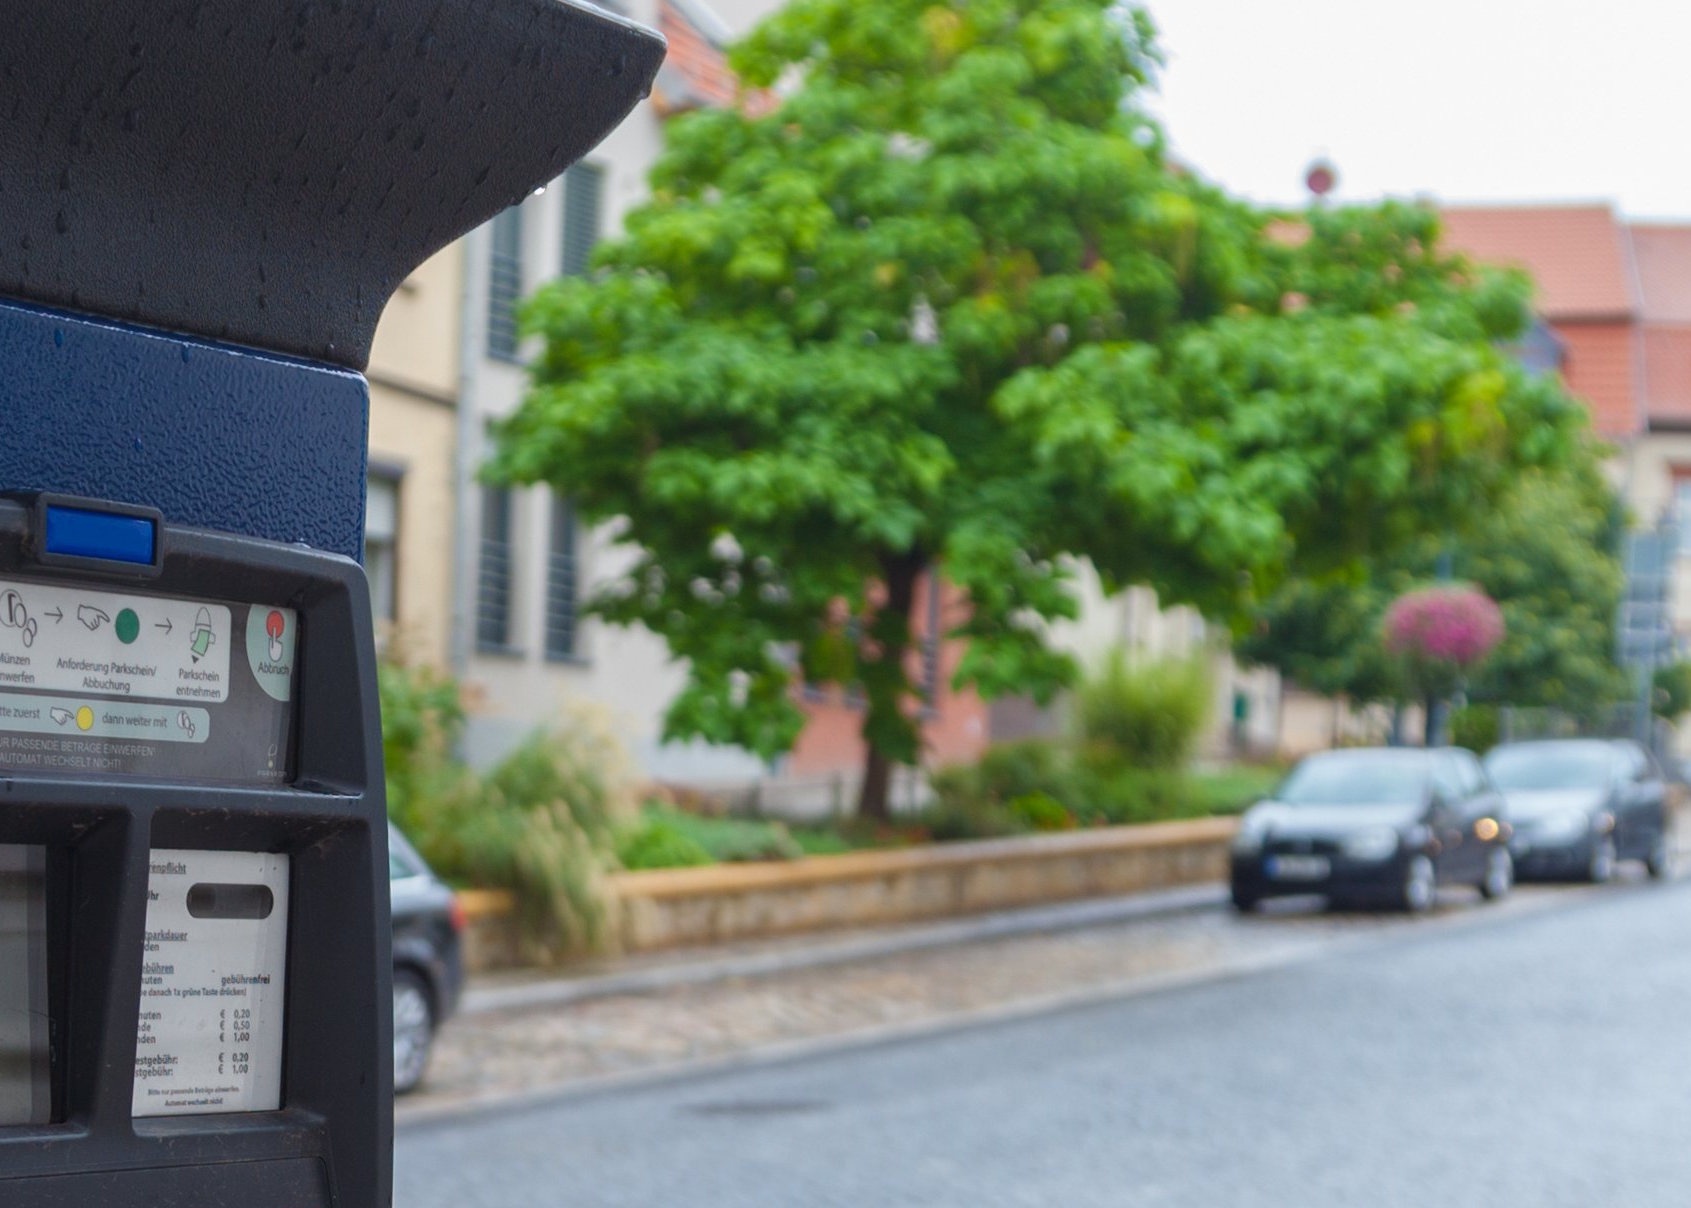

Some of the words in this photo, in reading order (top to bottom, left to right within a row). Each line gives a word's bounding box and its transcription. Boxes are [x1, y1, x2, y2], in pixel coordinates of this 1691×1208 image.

[56, 658, 109, 675] Anforderung
[111, 662, 157, 677] Parkschein/
[257, 662, 289, 675] Abbruch
[178, 668, 220, 682] Parkschein
[82, 676, 131, 693] Abbuchung
[176, 686, 221, 699] entnehmen
[13, 707, 41, 720] zuerst
[102, 712, 124, 726] dann
[126, 715, 151, 727] weiter
[153, 715, 168, 728] mit
[11, 738, 59, 751] PASSENDE
[43, 755, 92, 767] WECHSELT
[221, 974, 271, 987] gebührenfrei
[233, 1009, 251, 1020] 0,20
[233, 1021, 250, 1031] 0,50
[233, 1032, 250, 1043] 1,00
